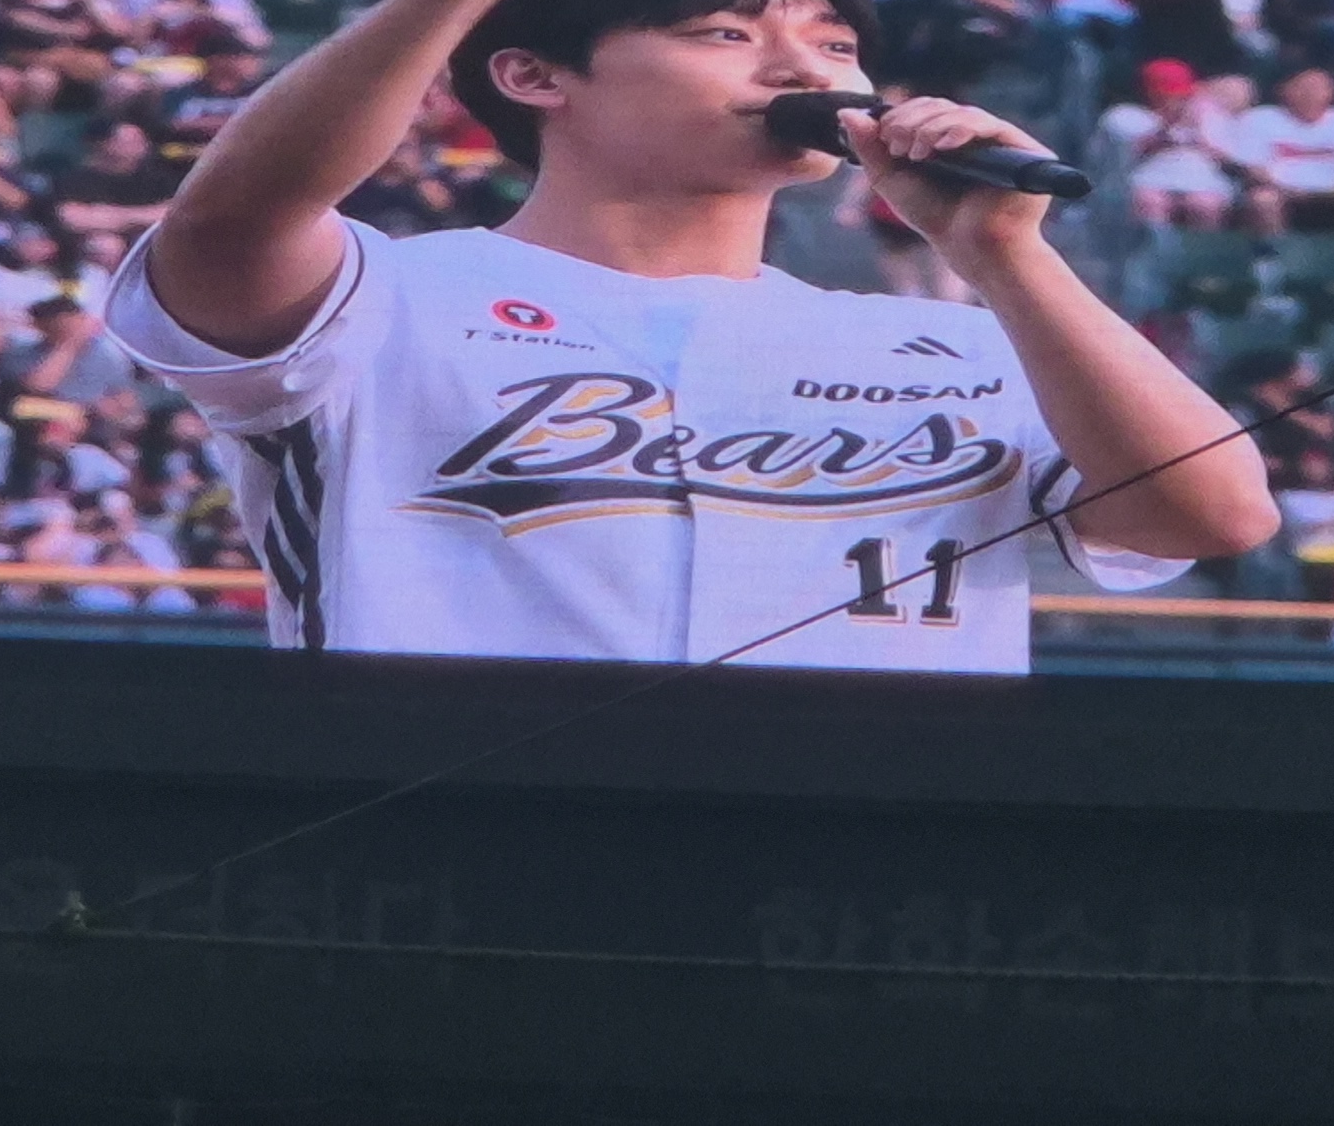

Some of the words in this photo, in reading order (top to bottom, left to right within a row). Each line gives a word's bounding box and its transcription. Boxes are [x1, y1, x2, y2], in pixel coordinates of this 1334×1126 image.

[430, 372, 1027, 499] Bears
[792, 377, 1002, 404] DOOSAN
[845, 536, 963, 626] 11
